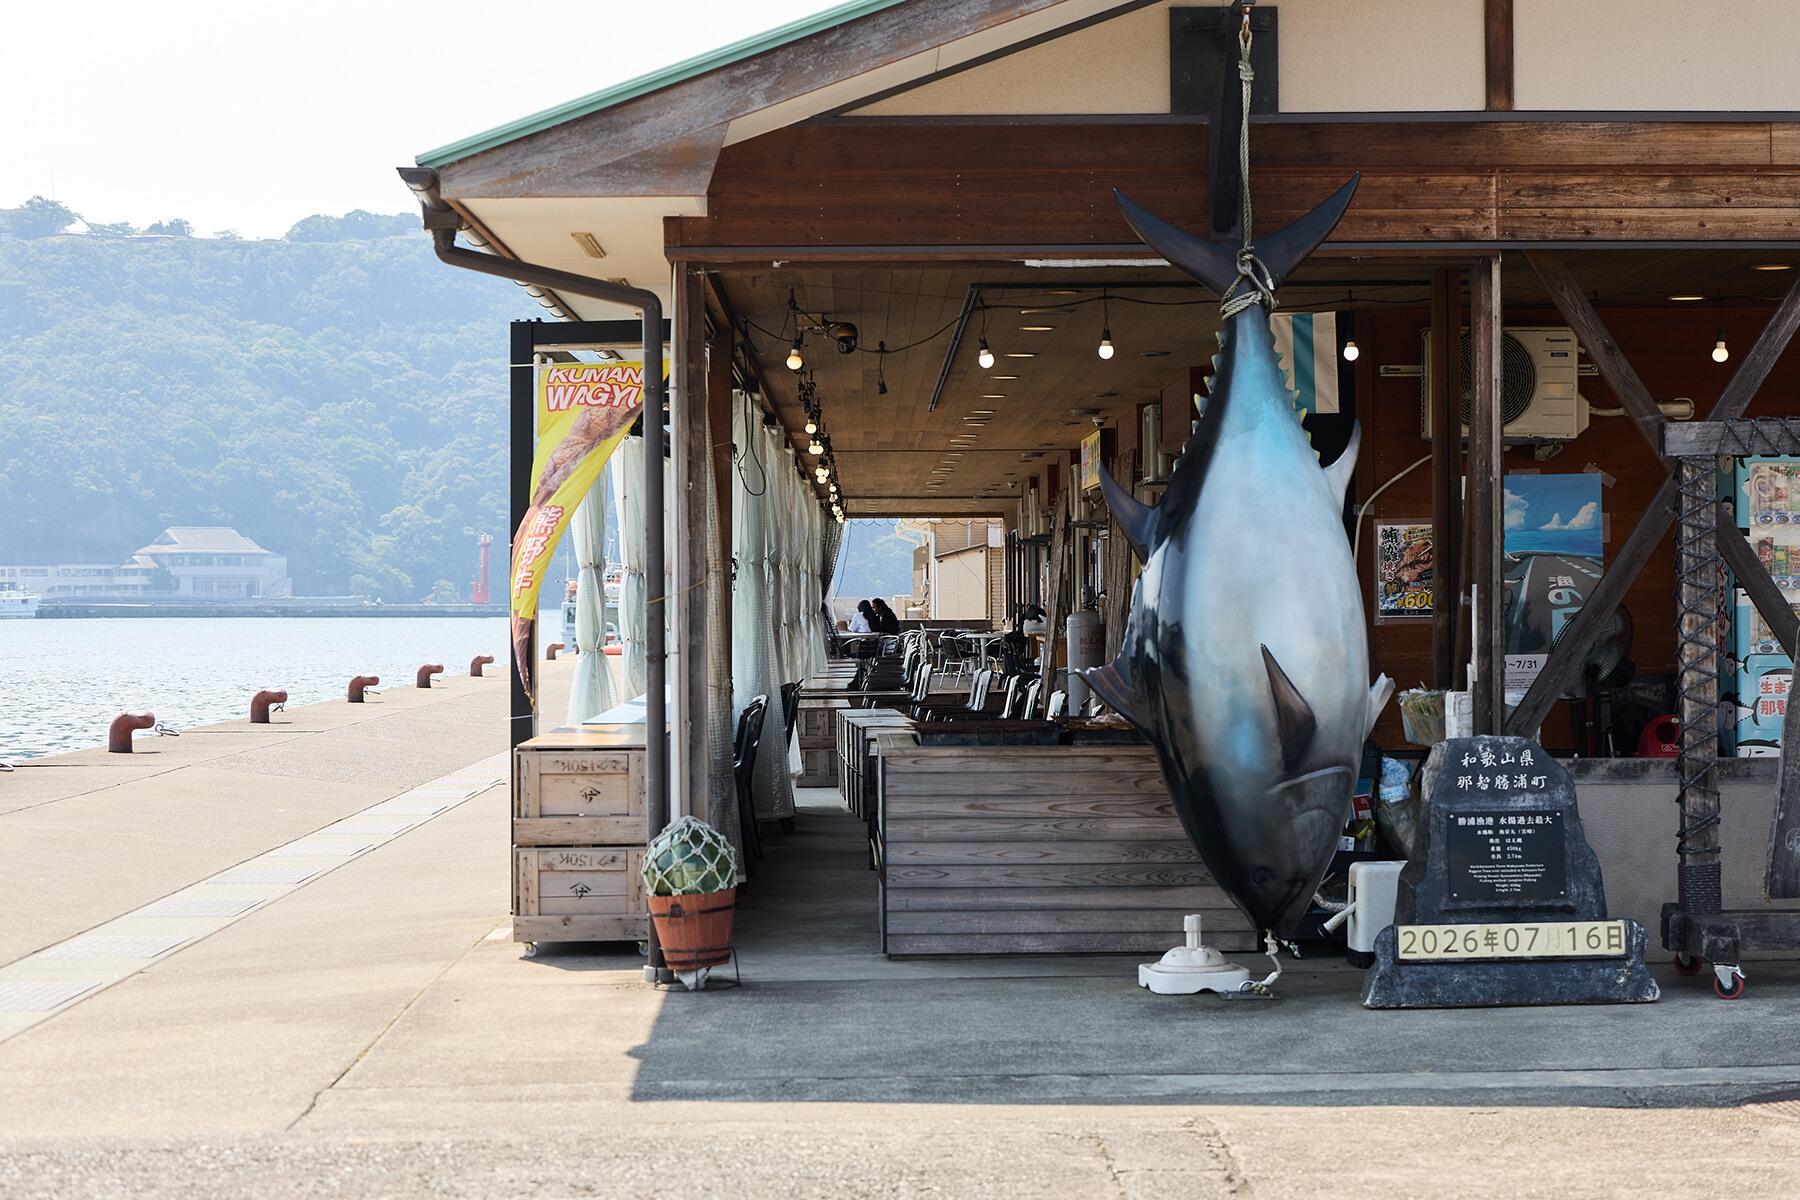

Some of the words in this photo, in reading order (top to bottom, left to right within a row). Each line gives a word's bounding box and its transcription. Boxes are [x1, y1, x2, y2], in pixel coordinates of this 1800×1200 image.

[548, 367, 643, 384] KUMAN
[514, 505, 564, 598] 熊野牛
[1760, 681, 1792, 694] 生ま
[1461, 749, 1534, 768] 和歌山県
[1457, 774, 1547, 791] 那智勝浦町
[1402, 925, 1622, 954] 2026年07月16日
